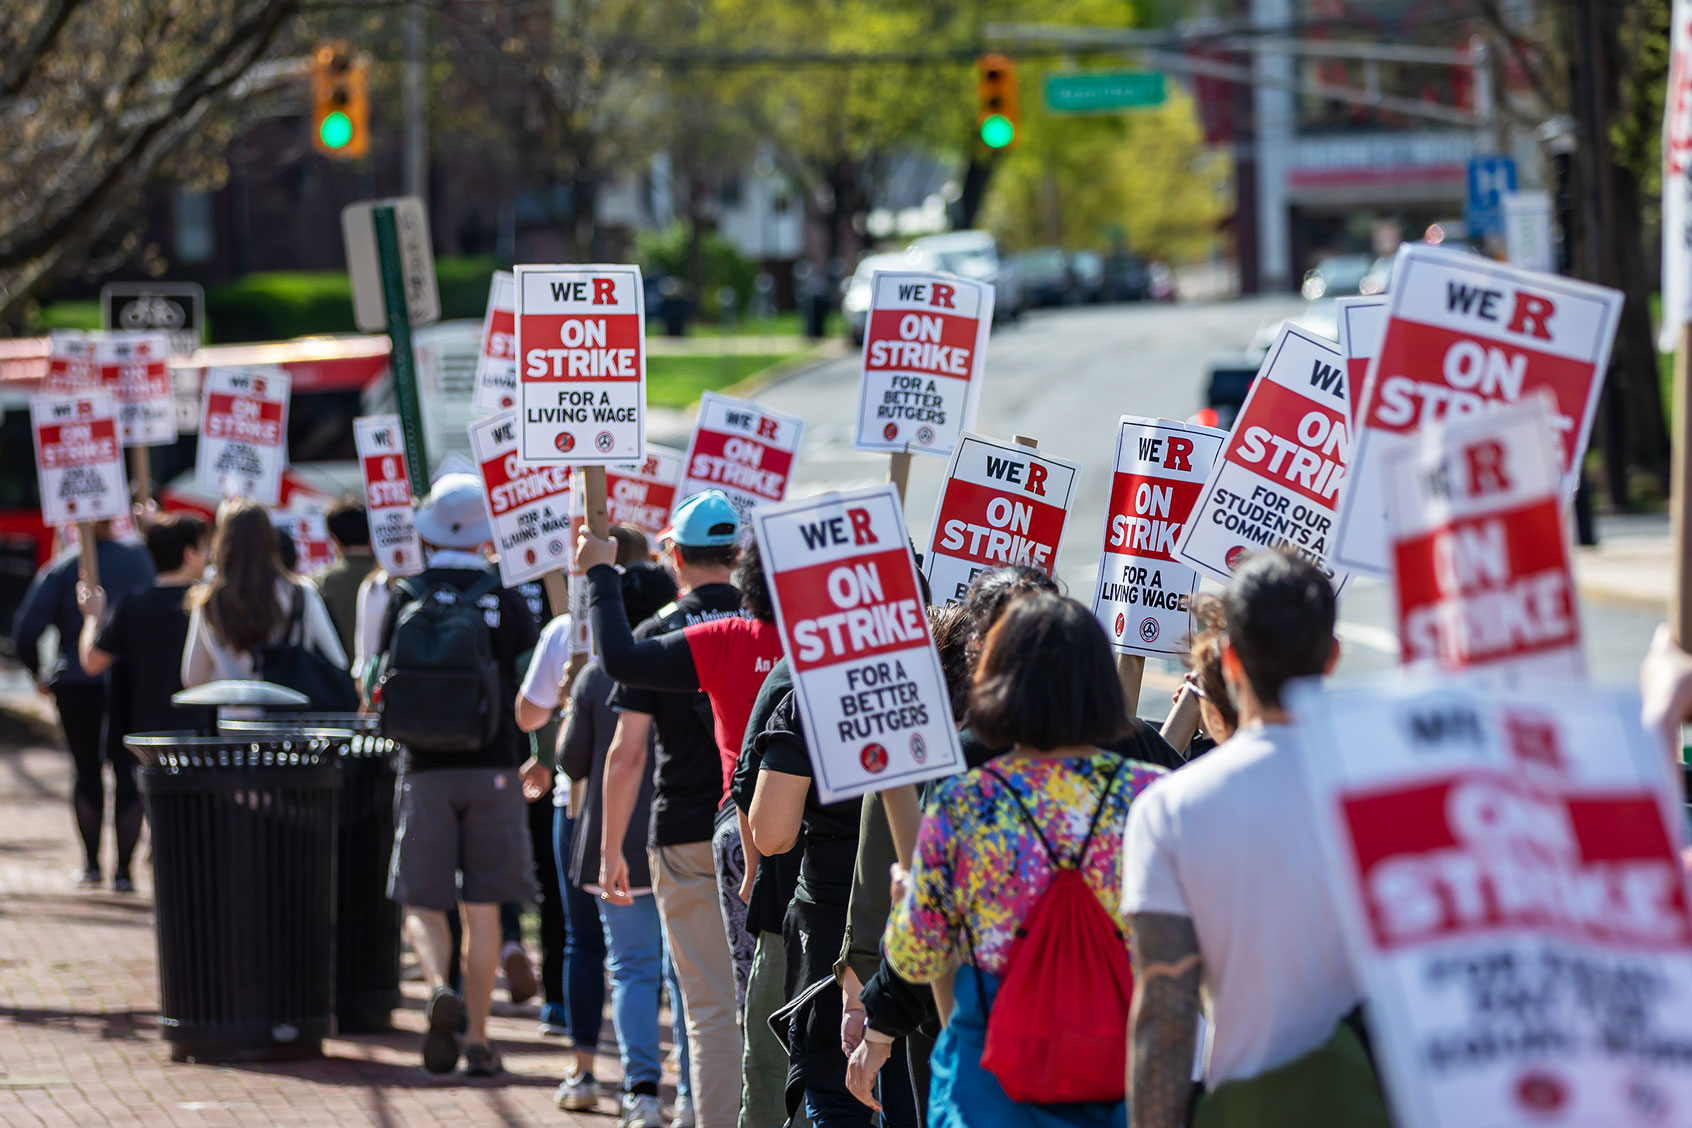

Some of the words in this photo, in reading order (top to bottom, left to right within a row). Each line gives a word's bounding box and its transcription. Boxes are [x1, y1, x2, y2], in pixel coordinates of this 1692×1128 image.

[550, 281, 587, 302] WE
[591, 277, 619, 306] R
[899, 284, 926, 302] WE
[929, 282, 956, 309] R
[898, 313, 944, 343] ON
[1447, 280, 1503, 322] WE
[1505, 290, 1557, 341] R
[559, 318, 607, 348] ON
[525, 348, 637, 378] STRIKE
[868, 339, 970, 376] STRIKE
[1442, 339, 1528, 405] ON
[558, 390, 594, 406] FOR
[599, 391, 610, 406] A
[883, 391, 943, 409] BETTER
[890, 376, 922, 391] FOR
[925, 380, 936, 393] A
[527, 408, 587, 423] LIVING
[591, 408, 637, 423] WAGE
[726, 410, 753, 431] WE
[756, 415, 779, 441] R
[877, 405, 946, 426] RUTGERS
[722, 437, 765, 470] ON
[1138, 437, 1163, 463] WE
[1163, 435, 1194, 472] R
[1236, 425, 1349, 502] STRIK
[1462, 437, 1513, 498] R
[490, 464, 569, 513] STRIKE
[612, 479, 649, 506] ON
[690, 452, 786, 499] STRIKE
[986, 455, 1025, 485] WE
[1024, 461, 1048, 497] R
[986, 496, 1033, 536] ON
[1134, 482, 1174, 518] ON
[1212, 488, 1312, 546] STUDENTS
[1251, 484, 1291, 515] FOR
[1292, 505, 1332, 536] OUR
[799, 516, 849, 551] WE
[847, 507, 879, 547] R
[1110, 514, 1185, 554] STRIK
[827, 561, 885, 609] ON
[1122, 565, 1148, 587] FOR
[1150, 570, 1162, 588] A
[1101, 582, 1138, 605] LIVING
[1142, 588, 1189, 613] WAGE
[793, 599, 925, 663] STRIKE
[754, 656, 771, 673] An
[846, 662, 892, 692] FOR
[895, 659, 908, 681] A
[840, 681, 919, 717] BETTER
[837, 703, 930, 744] RUTGERS
